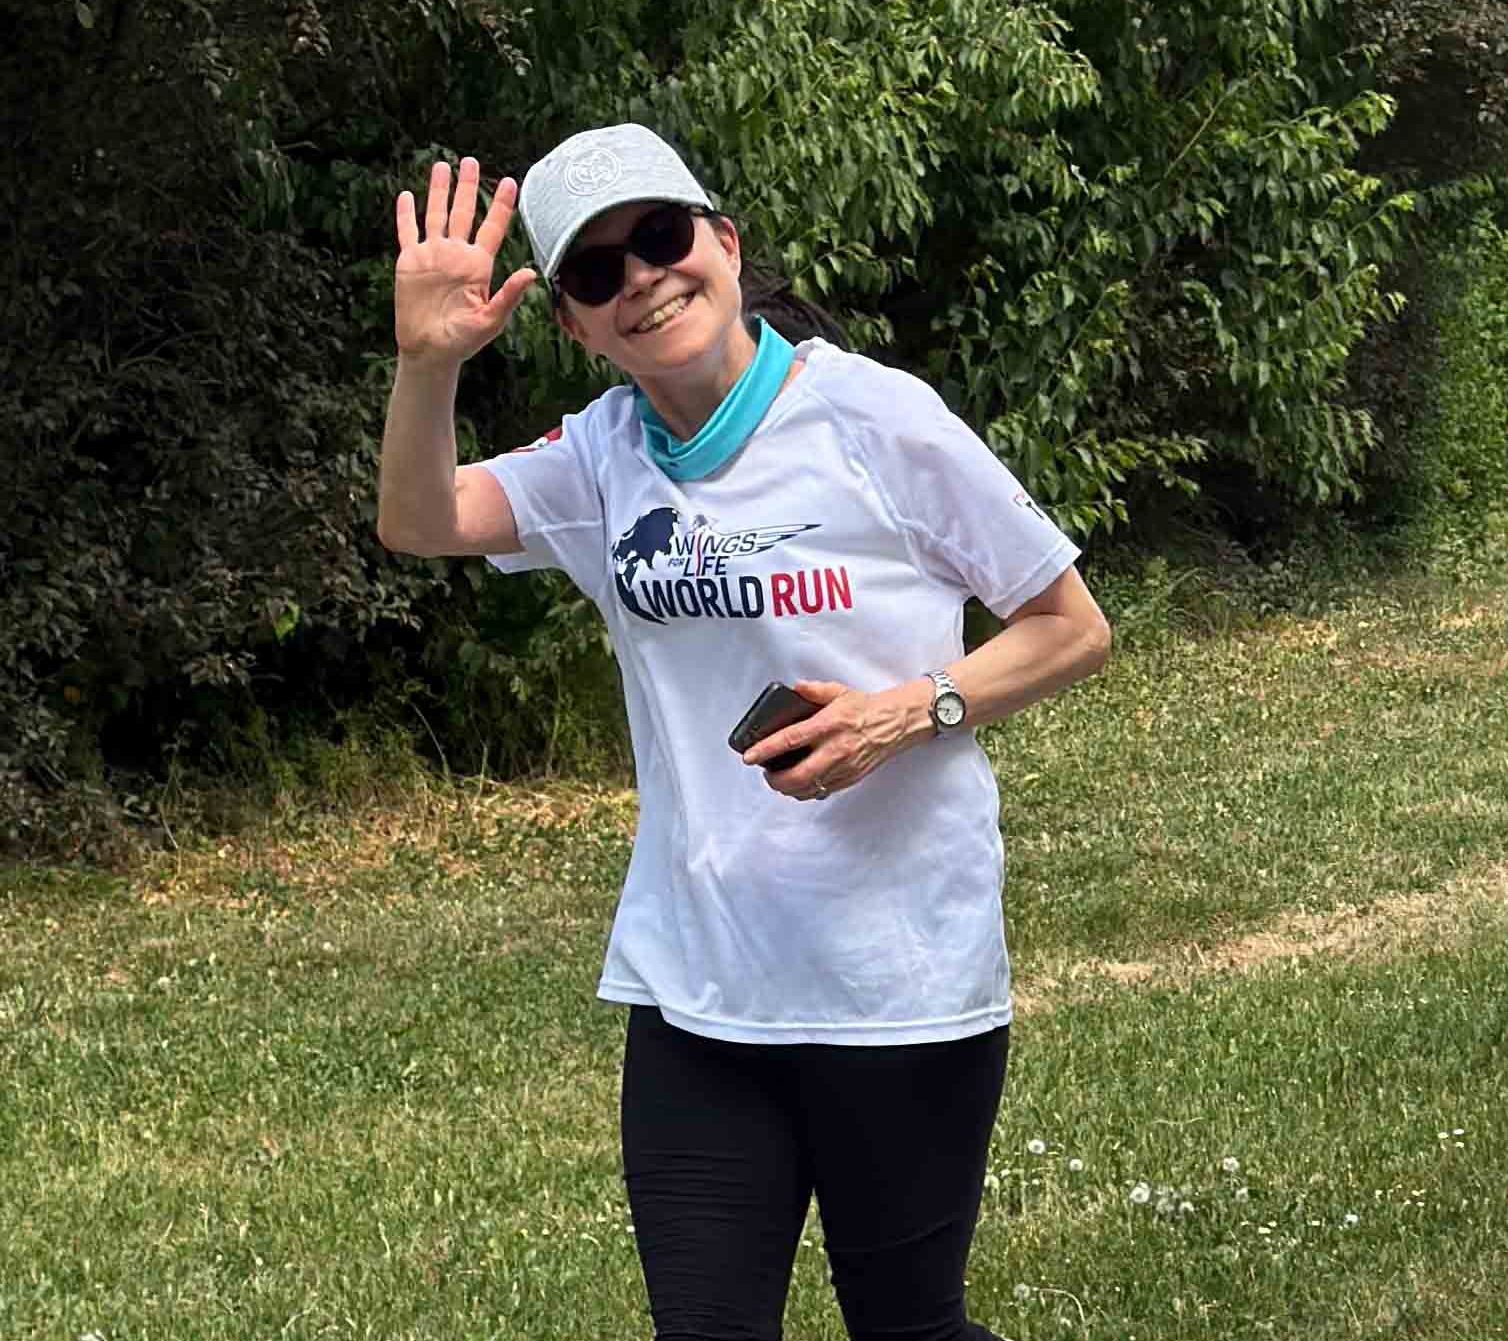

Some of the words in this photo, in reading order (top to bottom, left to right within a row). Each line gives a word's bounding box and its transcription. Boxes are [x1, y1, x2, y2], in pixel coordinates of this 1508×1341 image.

[674, 531, 757, 557] WINGS
[667, 557, 685, 567] FOR
[684, 555, 730, 578] LIFE
[640, 574, 765, 619] WORLD
[771, 565, 853, 618] RUN
